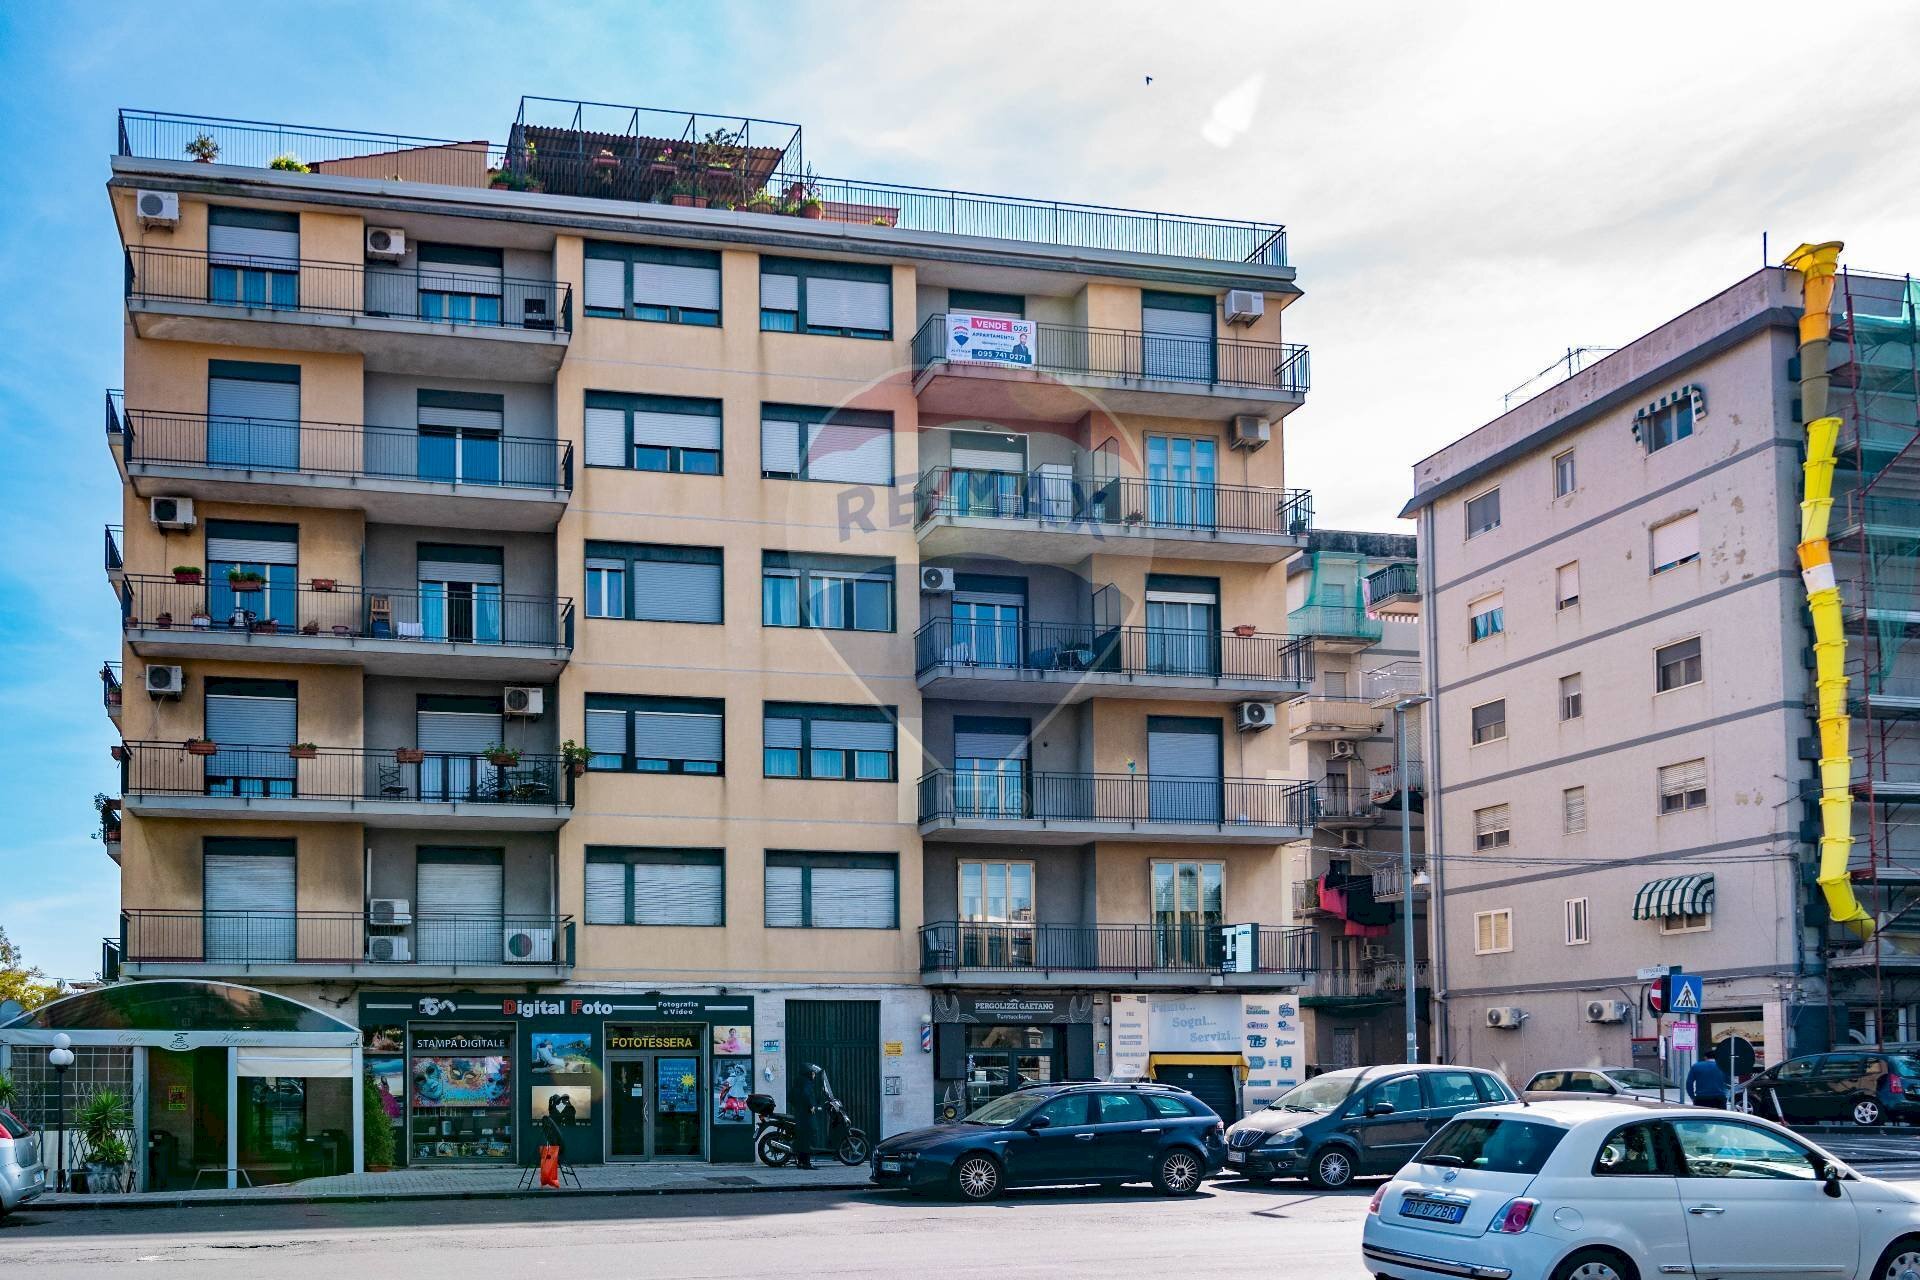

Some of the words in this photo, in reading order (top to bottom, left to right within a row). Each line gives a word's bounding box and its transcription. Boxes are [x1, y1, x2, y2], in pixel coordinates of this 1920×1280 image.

[976, 320, 1008, 330] VENDE
[972, 332, 1014, 340] APPARTAMENTO
[978, 350, 993, 358] 095
[1009, 353, 1026, 361] 0271
[503, 999, 565, 1017] Digital
[571, 999, 613, 1014] Foto
[658, 1001, 699, 1009] Fotografia
[975, 1002, 1018, 1010] PERGOLIZZI
[1020, 1002, 1054, 1010] GAETANO
[417, 1040, 458, 1048] STAMPA
[460, 1040, 505, 1048] DIGITALE
[612, 1038, 693, 1048] FOTOTESSERA
